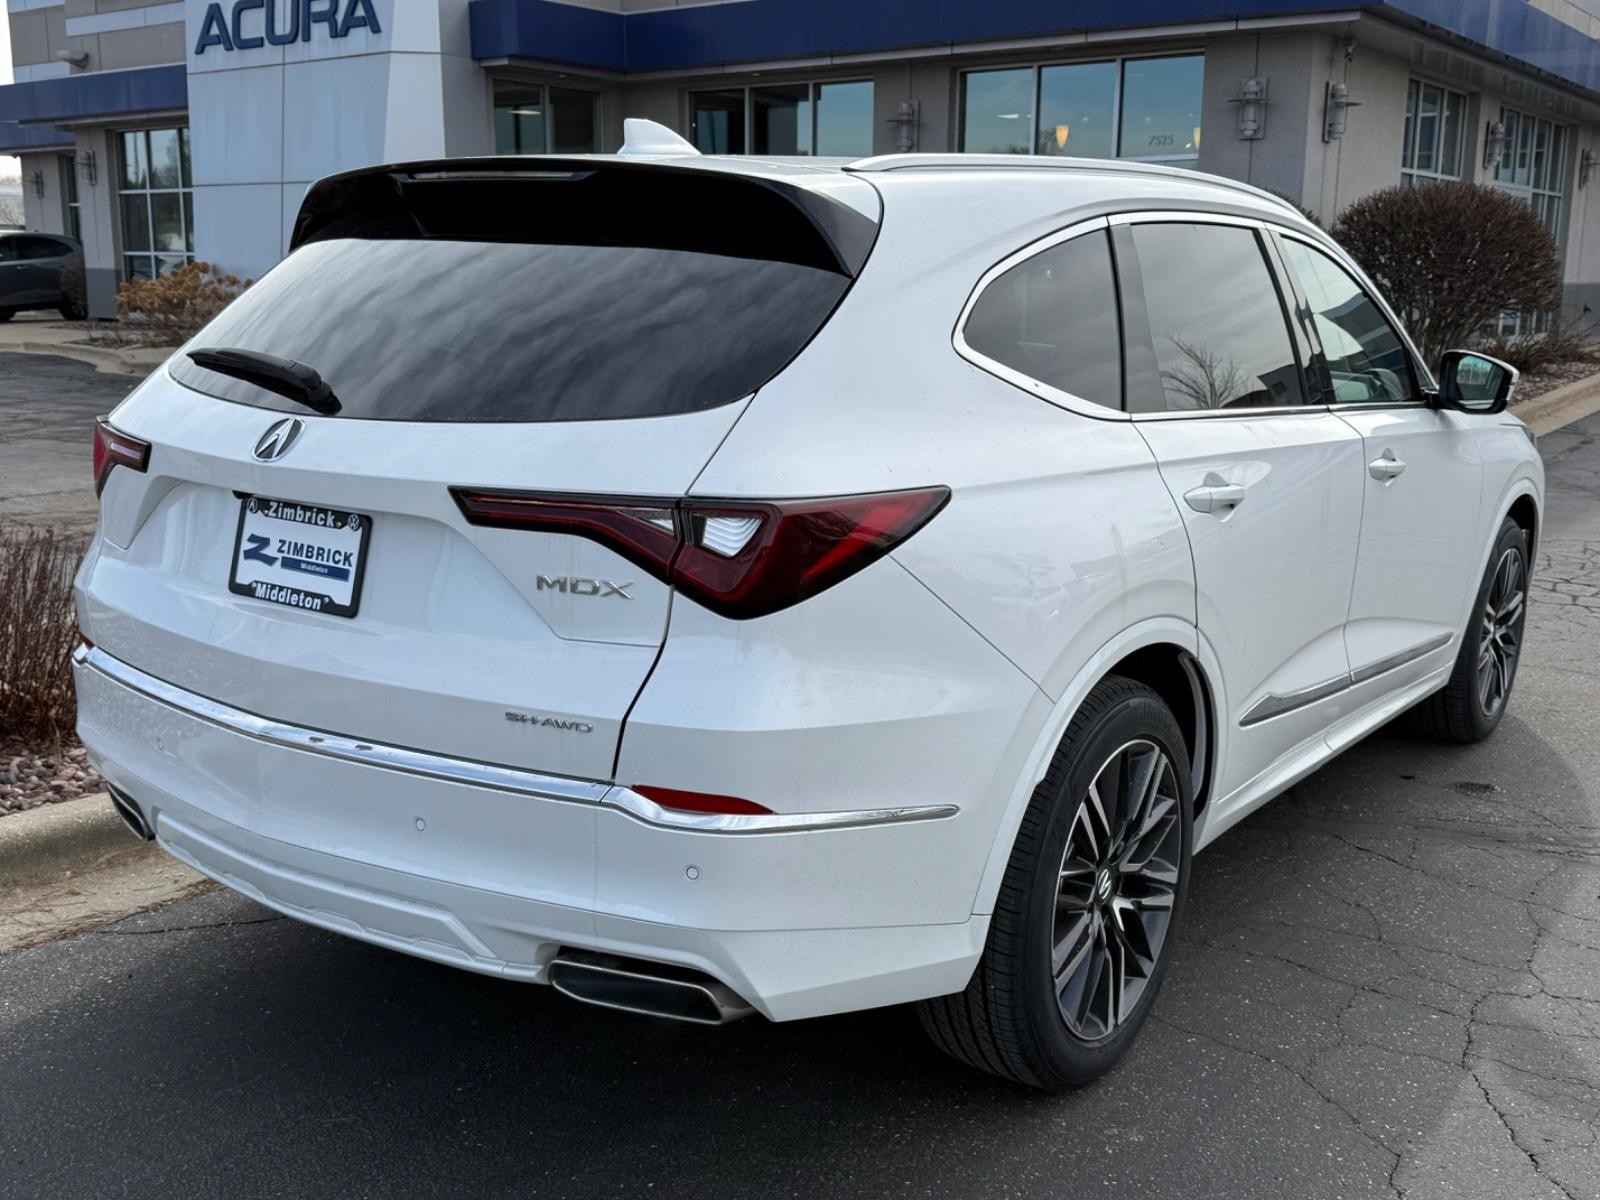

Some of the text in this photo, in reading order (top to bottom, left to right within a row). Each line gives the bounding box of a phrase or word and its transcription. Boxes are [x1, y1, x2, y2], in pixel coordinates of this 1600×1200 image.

[195, 0, 381, 55] ACURA
[268, 502, 335, 527] Zimbrick
[277, 539, 353, 567] ZIMBRICK
[255, 583, 321, 610] Middleton
[536, 575, 634, 600] MDX
